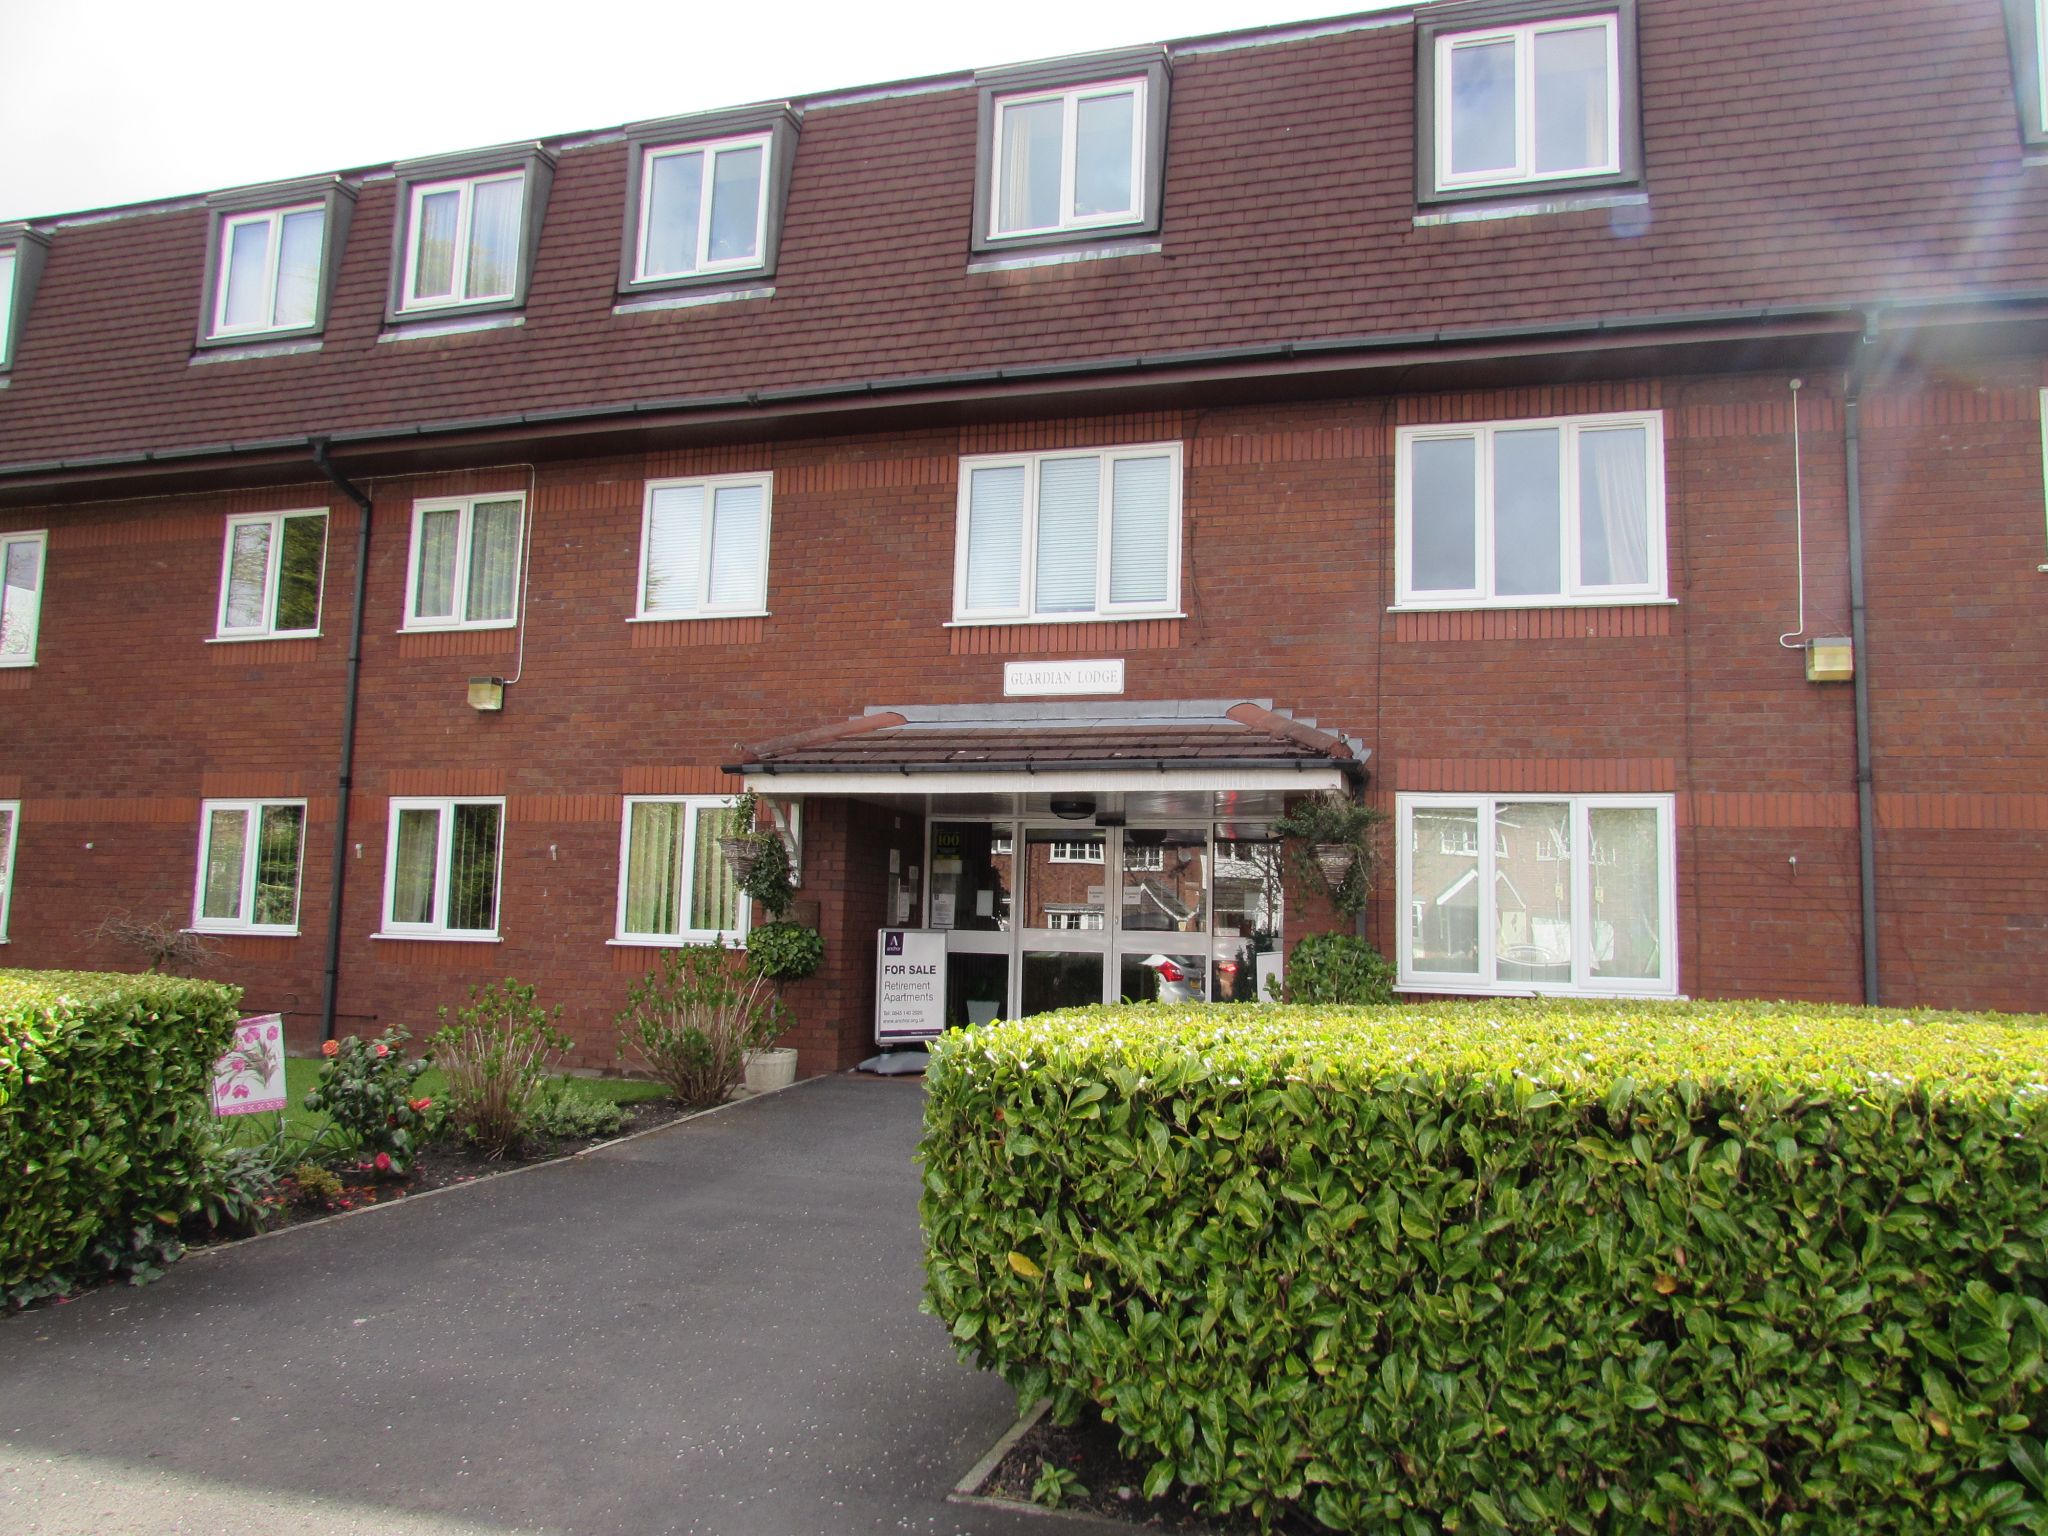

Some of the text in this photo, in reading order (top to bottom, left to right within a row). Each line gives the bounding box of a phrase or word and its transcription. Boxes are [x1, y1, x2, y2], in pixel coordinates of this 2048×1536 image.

[1010, 669, 1118, 685] GUARDIAN LODGE
[885, 965, 937, 975] FOR SALE
[884, 981, 930, 990] Retirement
[883, 993, 934, 1002] Apartments
